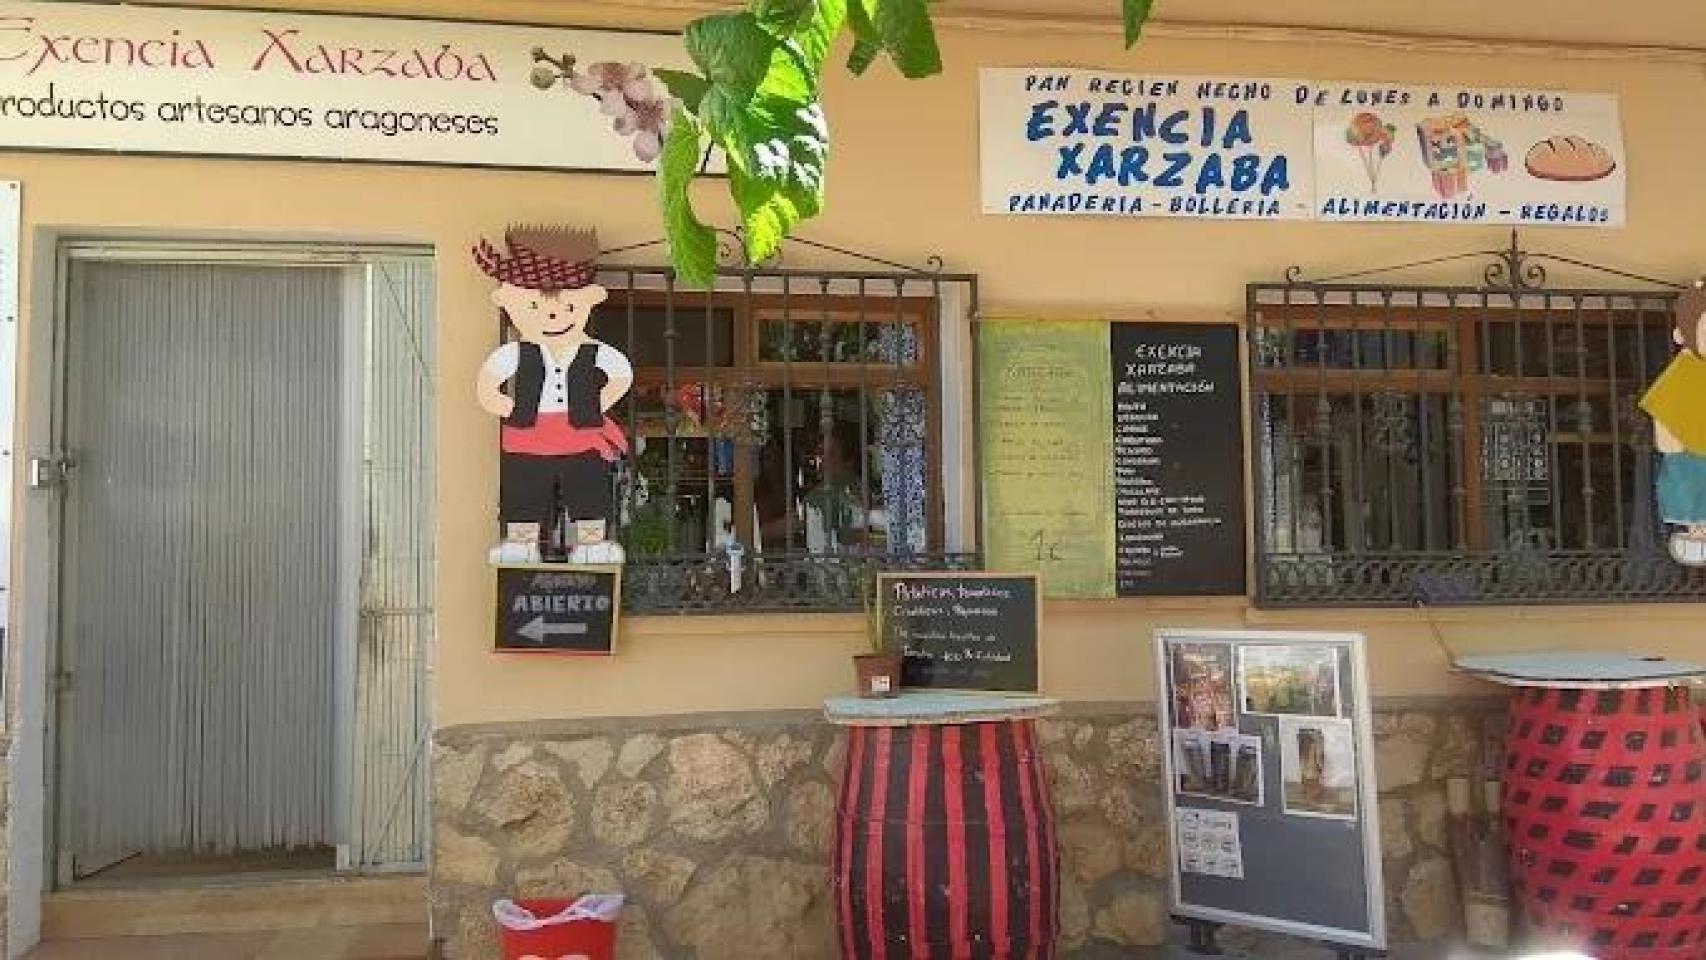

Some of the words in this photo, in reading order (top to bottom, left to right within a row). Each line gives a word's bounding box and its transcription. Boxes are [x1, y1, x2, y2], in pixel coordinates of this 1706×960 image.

[0, 17, 214, 76] Exencia
[0, 82, 145, 121] roductos
[157, 95, 312, 127] artesanos
[324, 107, 498, 137] aragoneses
[1025, 75, 1070, 92] PAN
[1295, 85, 1329, 106] DE
[1340, 88, 1410, 106] LUNES
[1427, 91, 1441, 108] A
[1457, 92, 1564, 112] DOMINGO
[1026, 100, 1251, 149] EXENCIA
[1056, 143, 1290, 197] XARZABA
[1009, 192, 1143, 213] PANADERIA
[1169, 196, 1280, 216] BOLLERIA
[1320, 193, 1487, 221] ALIMENTACIÓN
[1519, 204, 1610, 222] REGALOS
[512, 594, 609, 614] ABIERTO
